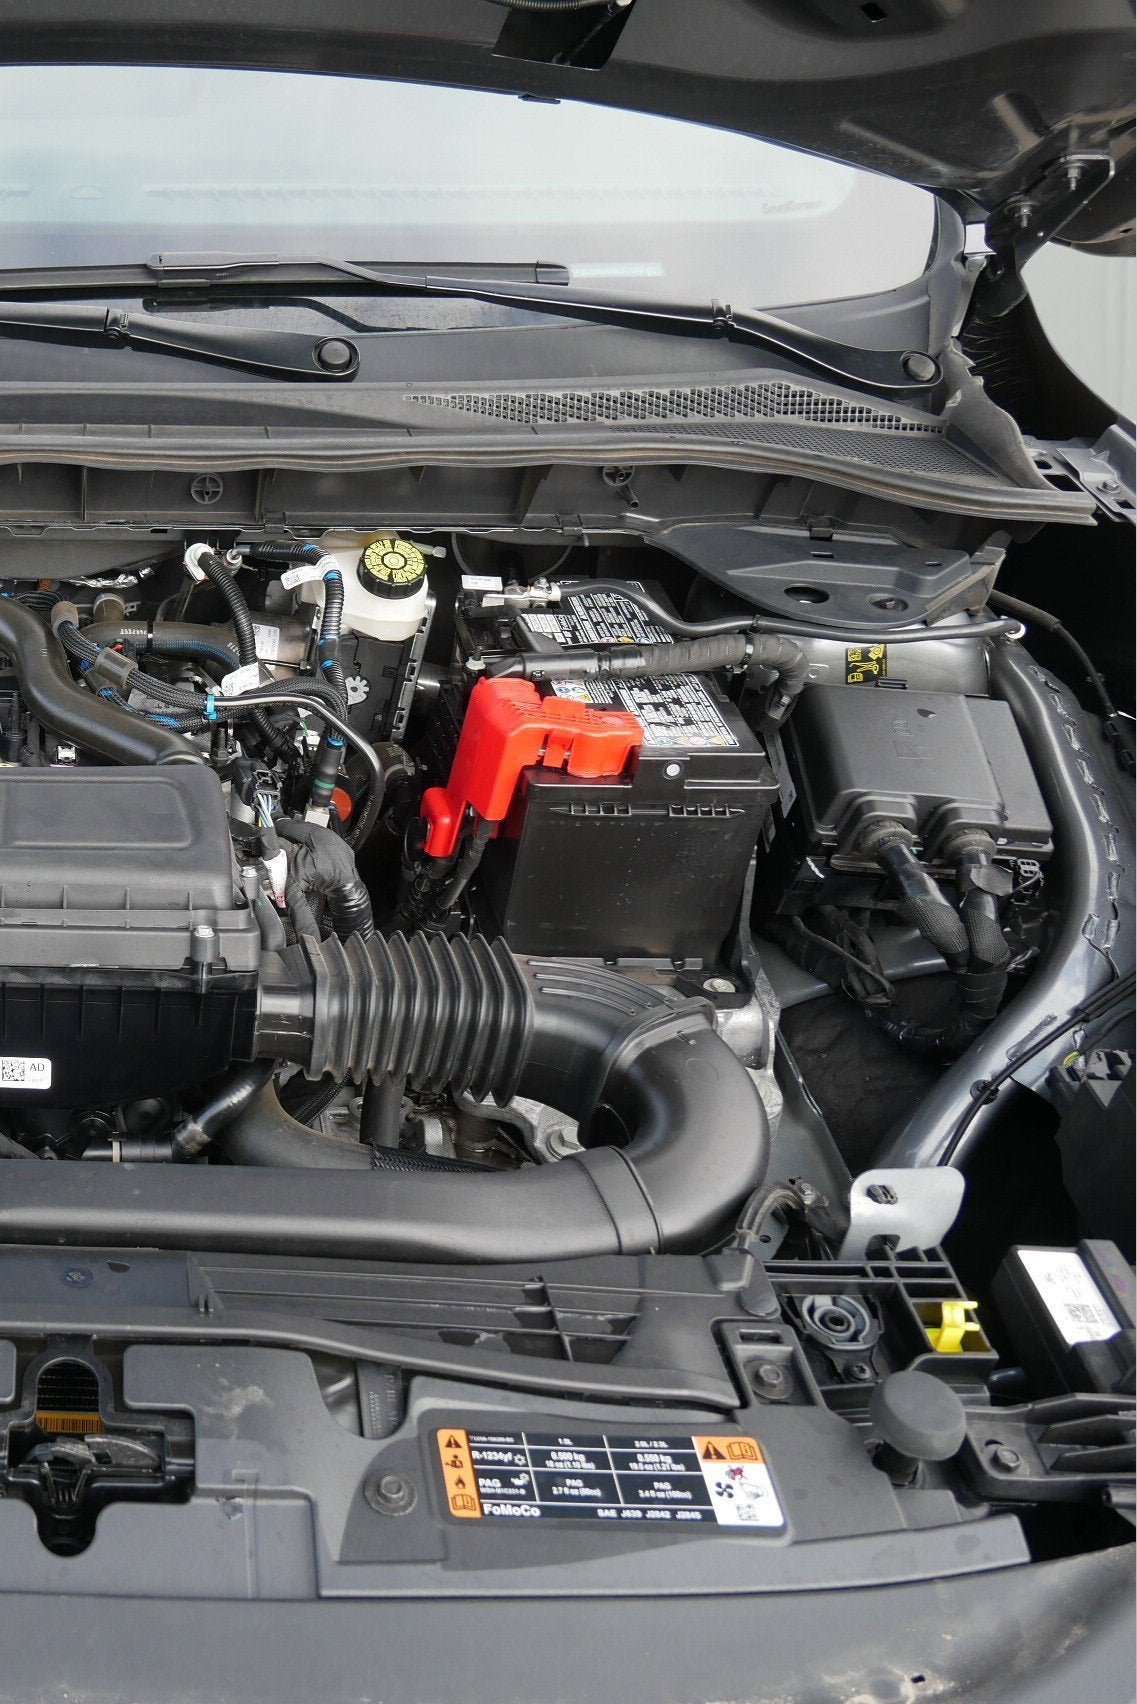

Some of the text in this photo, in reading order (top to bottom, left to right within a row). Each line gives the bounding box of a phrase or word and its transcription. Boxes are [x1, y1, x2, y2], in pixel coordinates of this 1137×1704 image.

[29, 1062, 45, 1072] AD
[471, 1450, 513, 1463] R-1234yf
[573, 1452, 586, 1463] kg
[659, 1454, 673, 1464] kg
[478, 1478, 501, 1487] PAG
[565, 1478, 583, 1487] PAG
[653, 1481, 671, 1490] PAG
[552, 1486, 564, 1495] 2.7
[483, 1503, 541, 1517] FoMoCo
[597, 1509, 618, 1518] SAE
